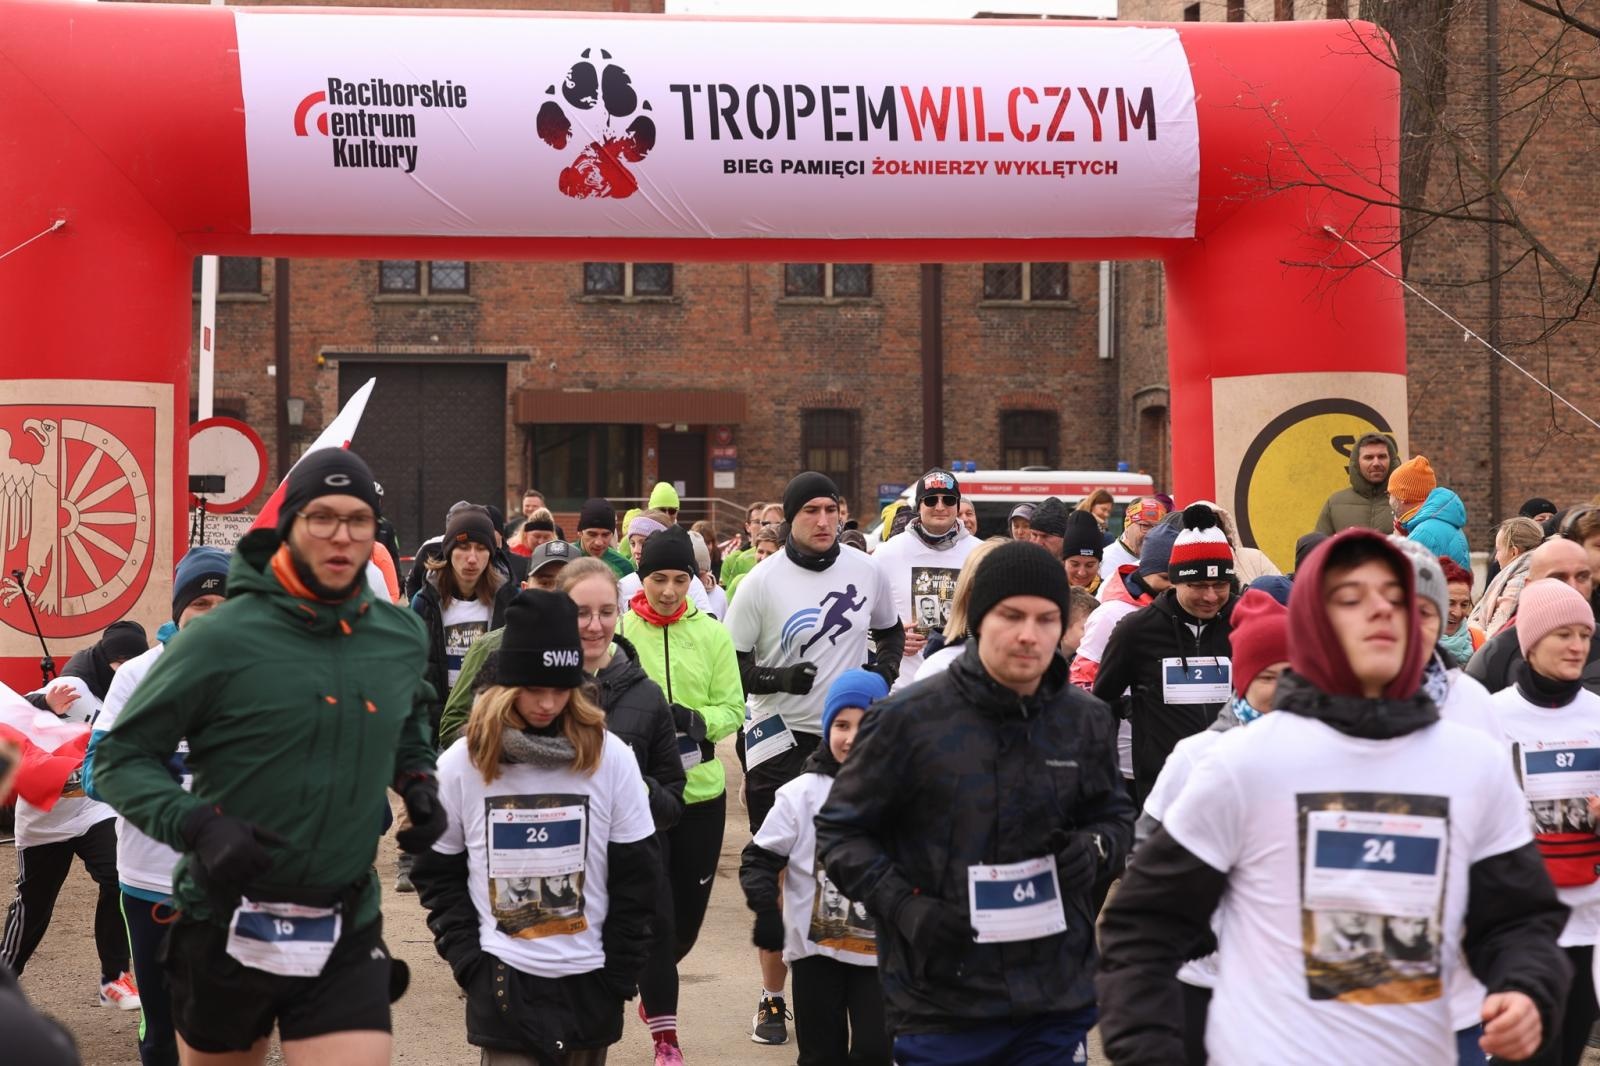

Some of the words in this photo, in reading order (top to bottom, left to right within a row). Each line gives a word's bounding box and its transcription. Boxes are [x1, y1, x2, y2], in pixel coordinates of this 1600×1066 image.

[328, 77, 468, 109] Raciborskie
[332, 138, 418, 173] Kultury
[723, 158, 774, 175] BIEG
[780, 159, 865, 179] PAMIĘCI
[871, 156, 989, 176] ŻOŁNIERZY
[994, 159, 1118, 179] WYKLĘTYCH
[542, 649, 580, 668] SWAG
[1193, 668, 1204, 681] 2
[752, 726, 764, 740] 16
[1555, 751, 1576, 769] 87
[526, 827, 549, 843] 26
[1362, 838, 1396, 864] 24
[1012, 880, 1036, 902] 64
